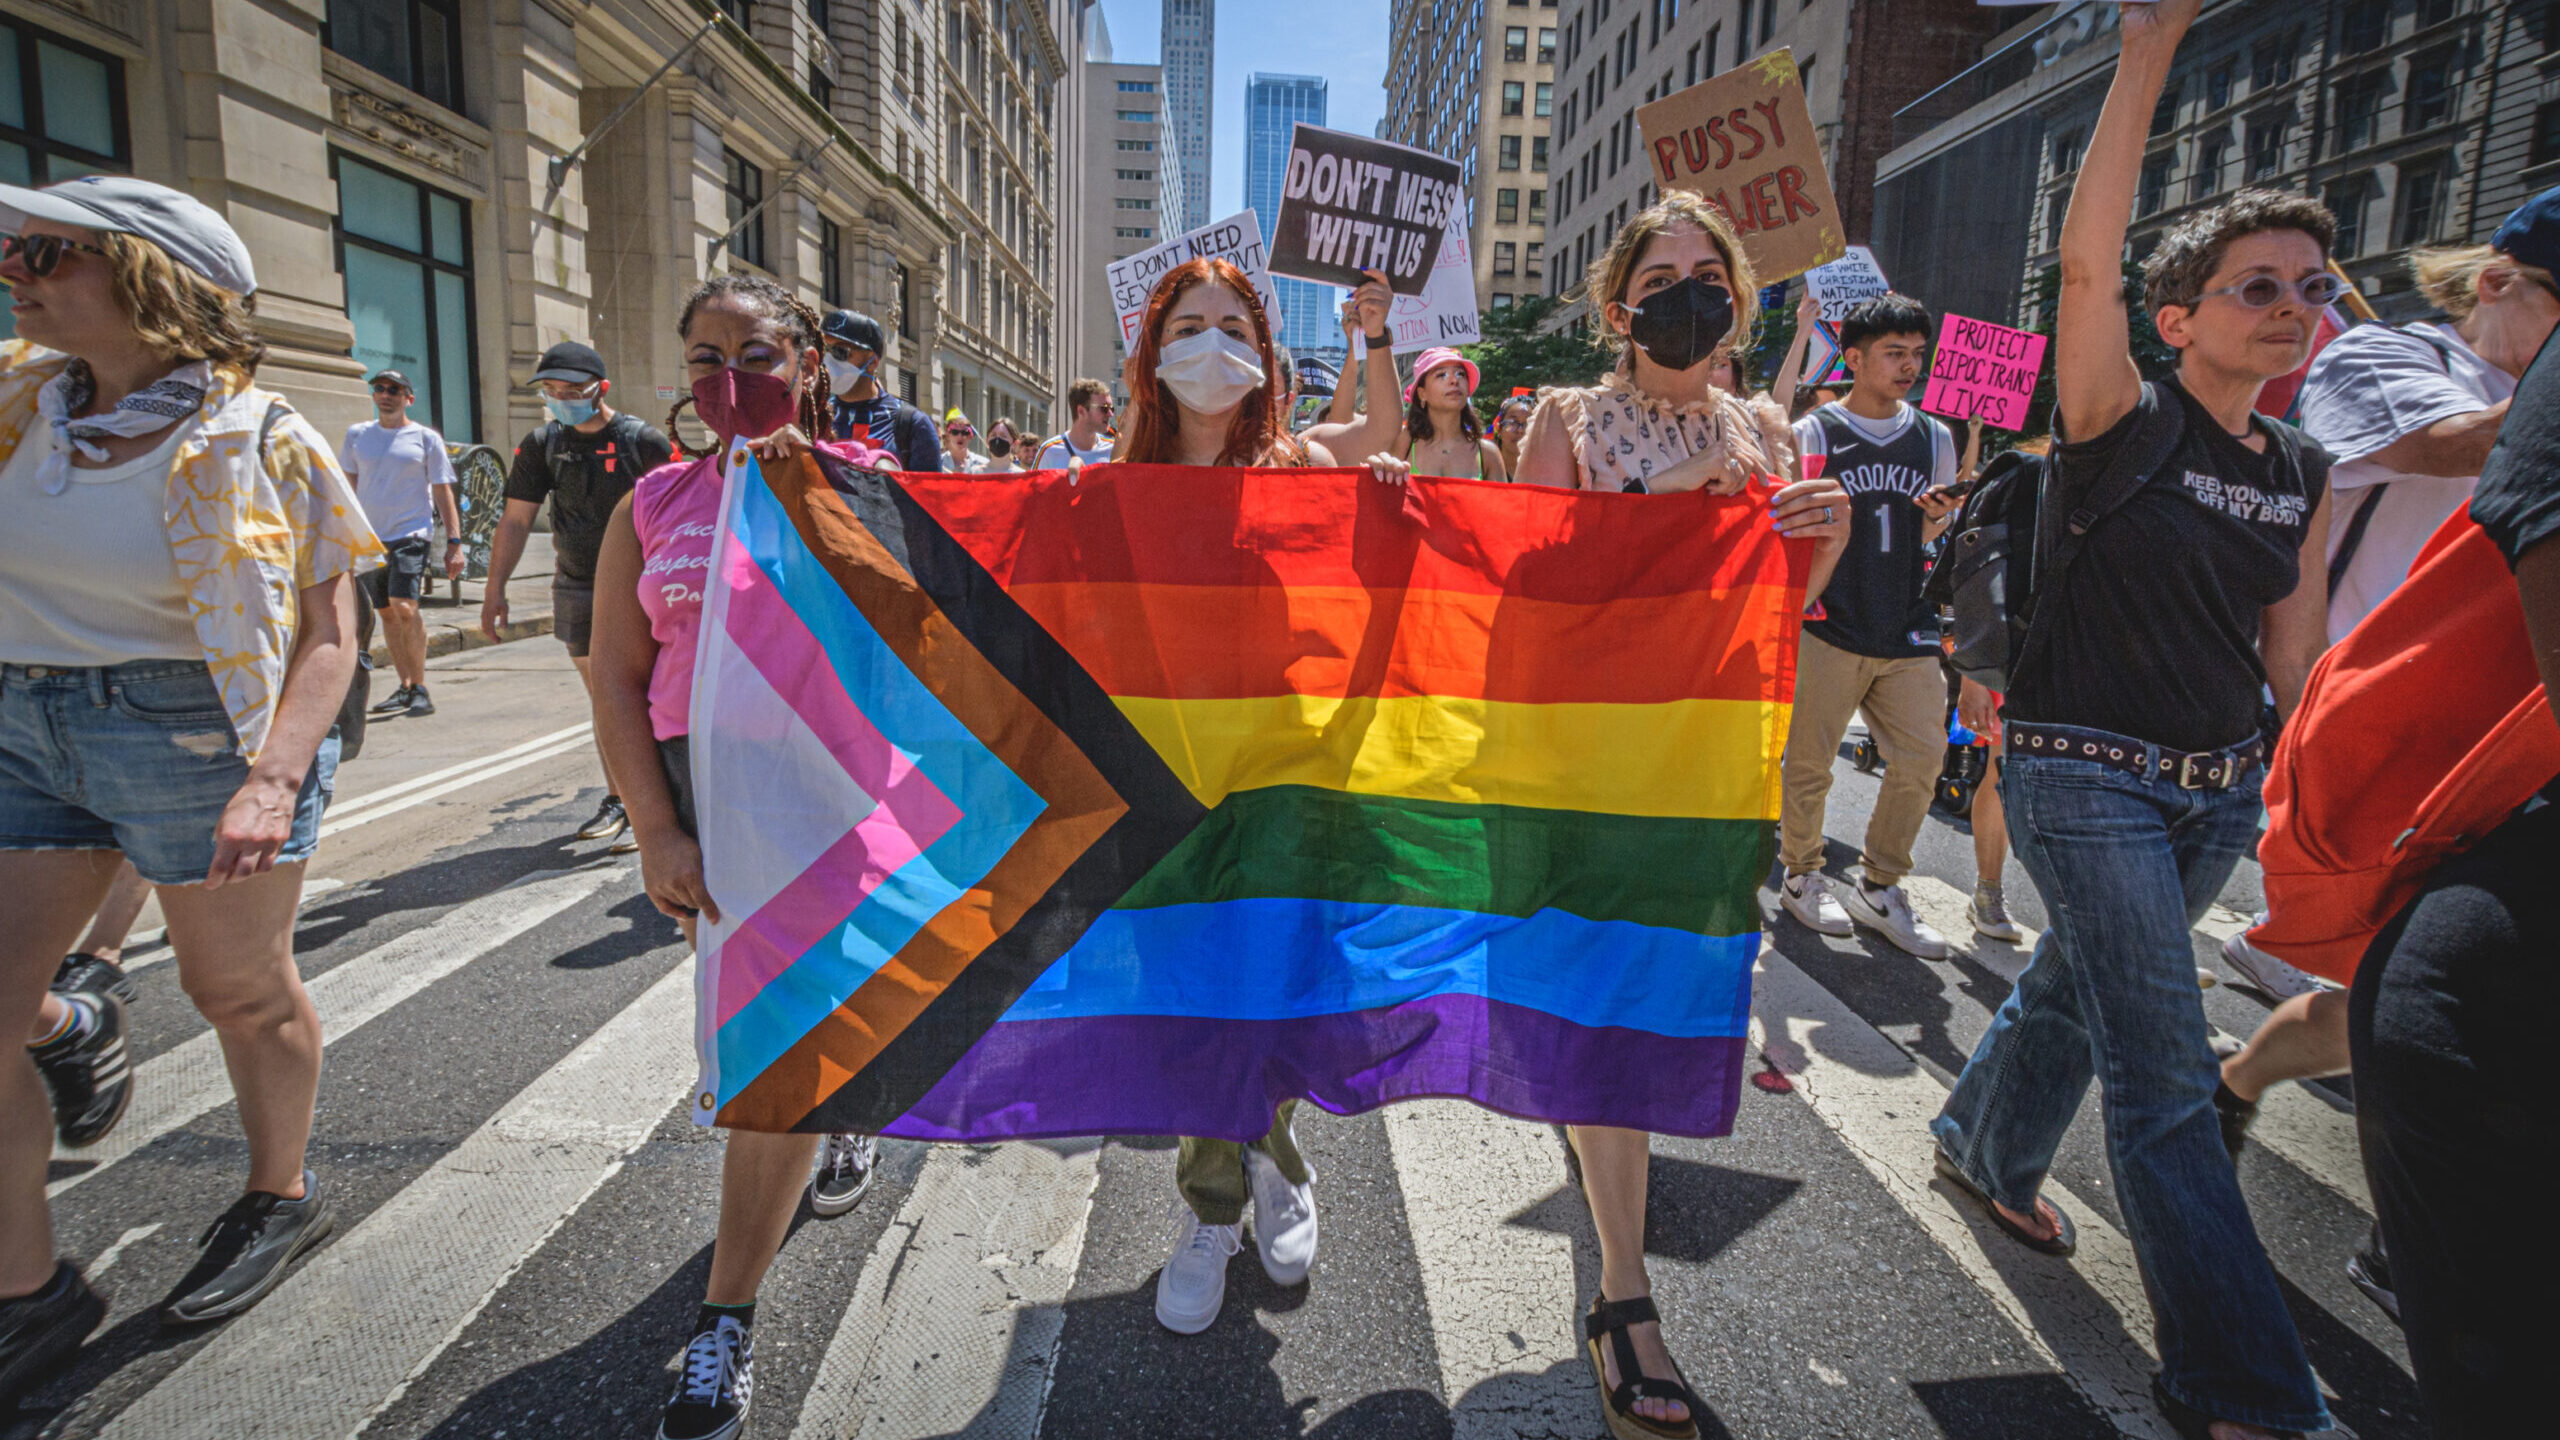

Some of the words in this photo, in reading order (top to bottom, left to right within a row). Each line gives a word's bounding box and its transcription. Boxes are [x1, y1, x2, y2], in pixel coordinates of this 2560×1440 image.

[1655, 97, 1785, 182] PUSSY
[1286, 148, 1392, 215] DON'T
[1394, 171, 1456, 230] MESS
[1703, 165, 1820, 238] WER
[1111, 266, 1128, 287] I
[1133, 245, 1181, 281] DON'T
[1188, 225, 1242, 259] NEED
[1307, 212, 1394, 273] WITH
[1394, 229, 1426, 278] US
[1836, 262, 1870, 273] WHITE
[1818, 275, 1878, 285] CHRISTIAN
[1439, 312, 1477, 339] NOW!
[1954, 319, 2033, 361] PROTECT
[1933, 348, 1986, 384] BIPOC
[1988, 361, 2036, 396] TRANS
[1936, 384, 2008, 424] LIVES
[1841, 463, 1929, 499] ROOKLY
[2196, 489, 2226, 510] OFF
[2229, 500, 2257, 520] MY
[1875, 504, 1890, 552] 1
